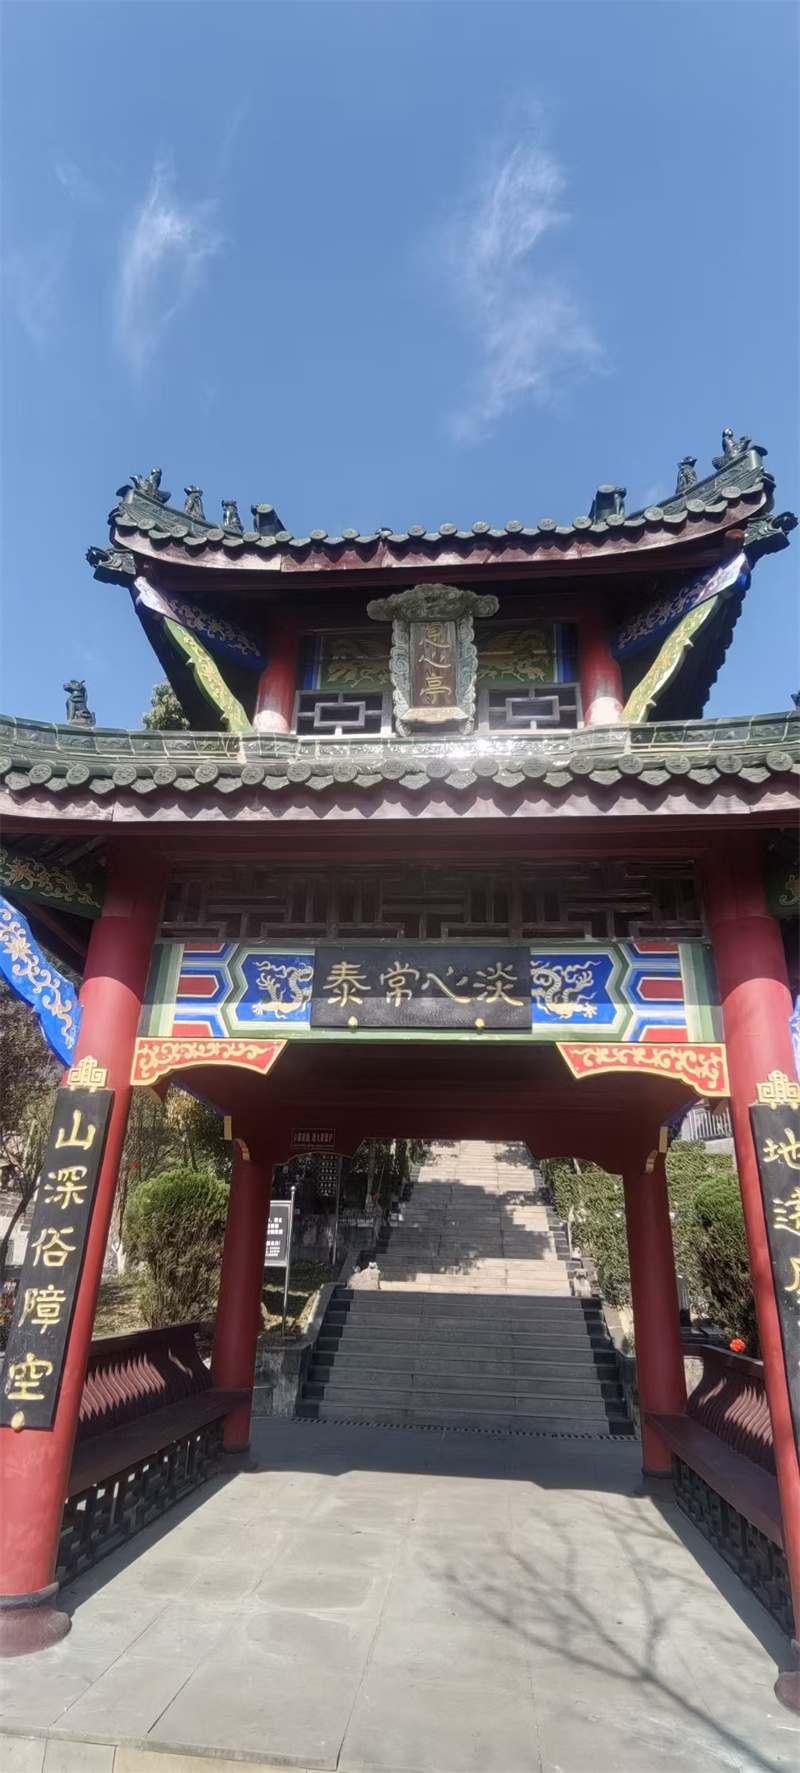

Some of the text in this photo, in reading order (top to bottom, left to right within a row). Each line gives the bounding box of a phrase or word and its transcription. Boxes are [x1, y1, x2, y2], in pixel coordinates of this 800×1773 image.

[7, 1109, 97, 1401] 山深俗障空
